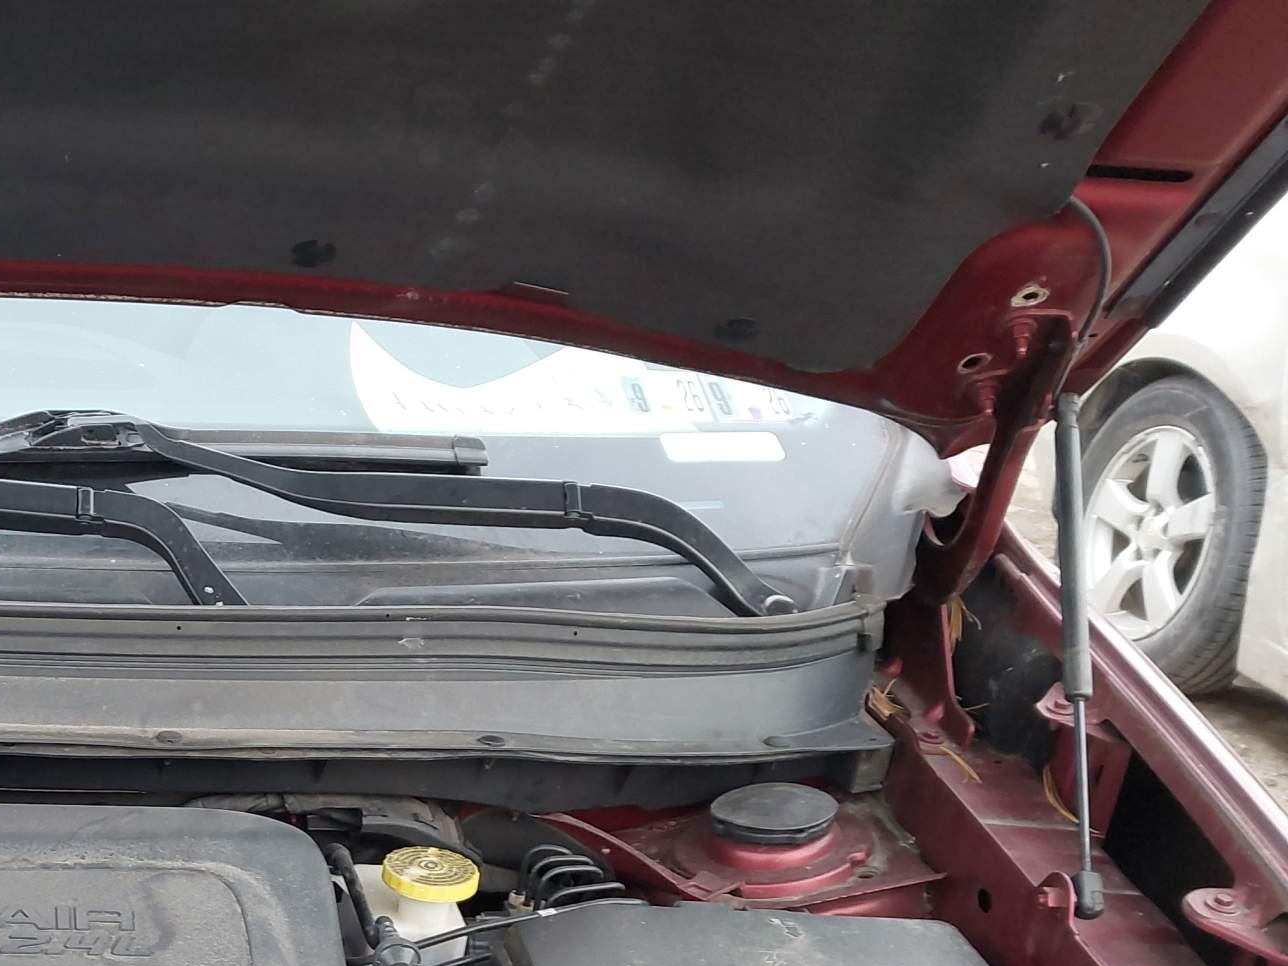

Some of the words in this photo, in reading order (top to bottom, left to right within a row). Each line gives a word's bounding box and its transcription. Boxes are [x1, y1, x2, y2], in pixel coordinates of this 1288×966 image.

[631, 383, 650, 412] 9
[676, 380, 704, 412] 26
[709, 382, 733, 415] 9
